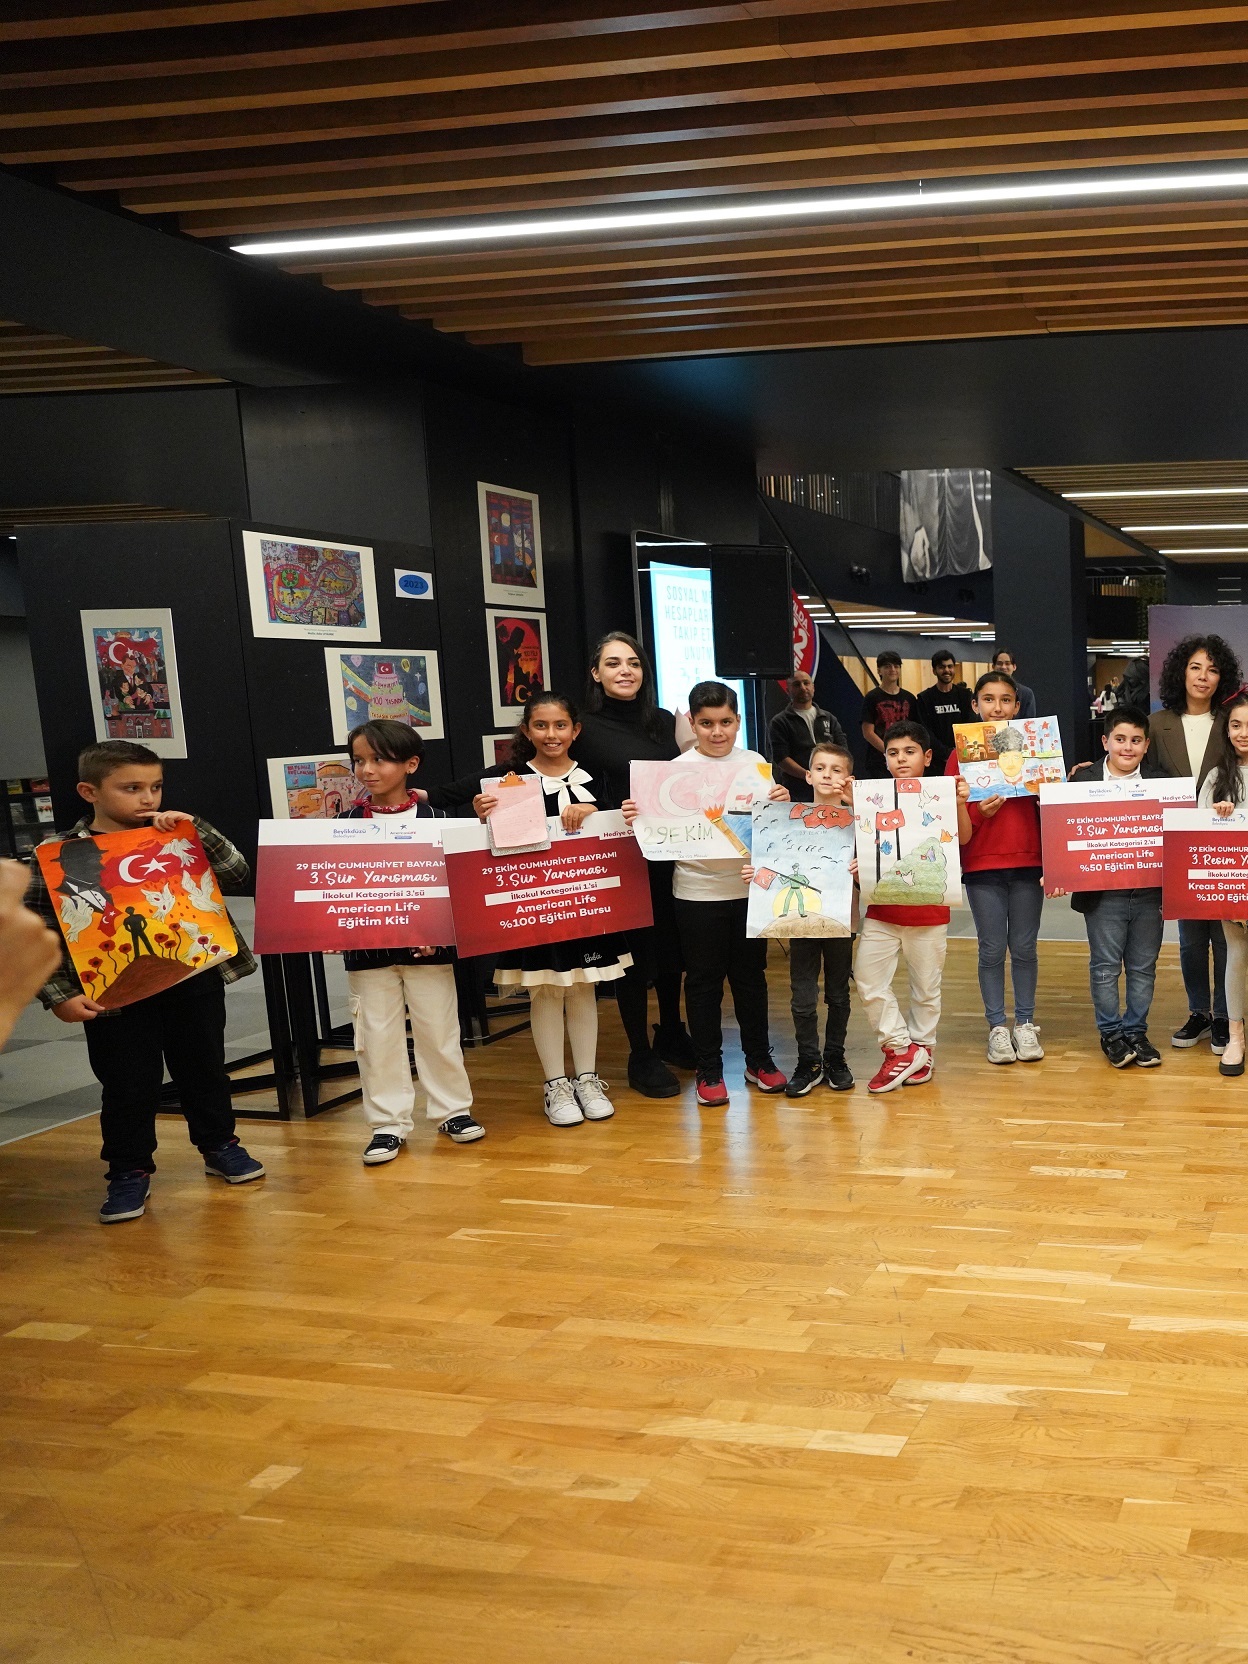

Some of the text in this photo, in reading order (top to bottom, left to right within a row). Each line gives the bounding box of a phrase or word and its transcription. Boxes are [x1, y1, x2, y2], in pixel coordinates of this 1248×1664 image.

[404, 580, 424, 590] 2023
[666, 585, 698, 602] SOSYAL
[664, 604, 712, 622] HESAPLARI
[684, 646, 713, 660] UNUTM
[1076, 816, 1094, 824] EKİM
[1094, 814, 1140, 824] CUMHURİYET
[604, 830, 626, 838] Hediye
[1076, 826, 1086, 836] 3.
[1109, 840, 1143, 848] Kategorisi
[1198, 844, 1216, 852] EKİM
[1090, 850, 1154, 860] American Life
[1192, 854, 1202, 865] 3.
[1202, 854, 1236, 866] Resim
[312, 860, 336, 870] EKİM
[338, 860, 404, 869] CUMHURİYET
[406, 860, 446, 868] BAYRAM
[495, 863, 518, 874] EKİM
[519, 856, 578, 871] CUMHURİYET
[579, 851, 618, 863] BAYRAMI
[1080, 861, 1163, 872] %50 Eğitim Bursu
[310, 870, 438, 886] 3. Şiir Yarışması
[496, 865, 608, 888] 3. Şiir Yarışması
[1208, 870, 1230, 878] İlkokul
[1188, 882, 1216, 890] Kreas
[1218, 882, 1246, 890] Sanat
[322, 890, 354, 899] İlkokul
[356, 890, 404, 900] Kategorisi
[510, 890, 539, 900] İlkokul
[540, 884, 582, 897] Kategorisi
[1196, 894, 1224, 902] %100
[326, 902, 421, 914] American Life
[516, 895, 597, 914] American Life
[338, 914, 410, 929] Eğitim Kiti
[500, 905, 612, 930] %100 Eğitim Bursu
